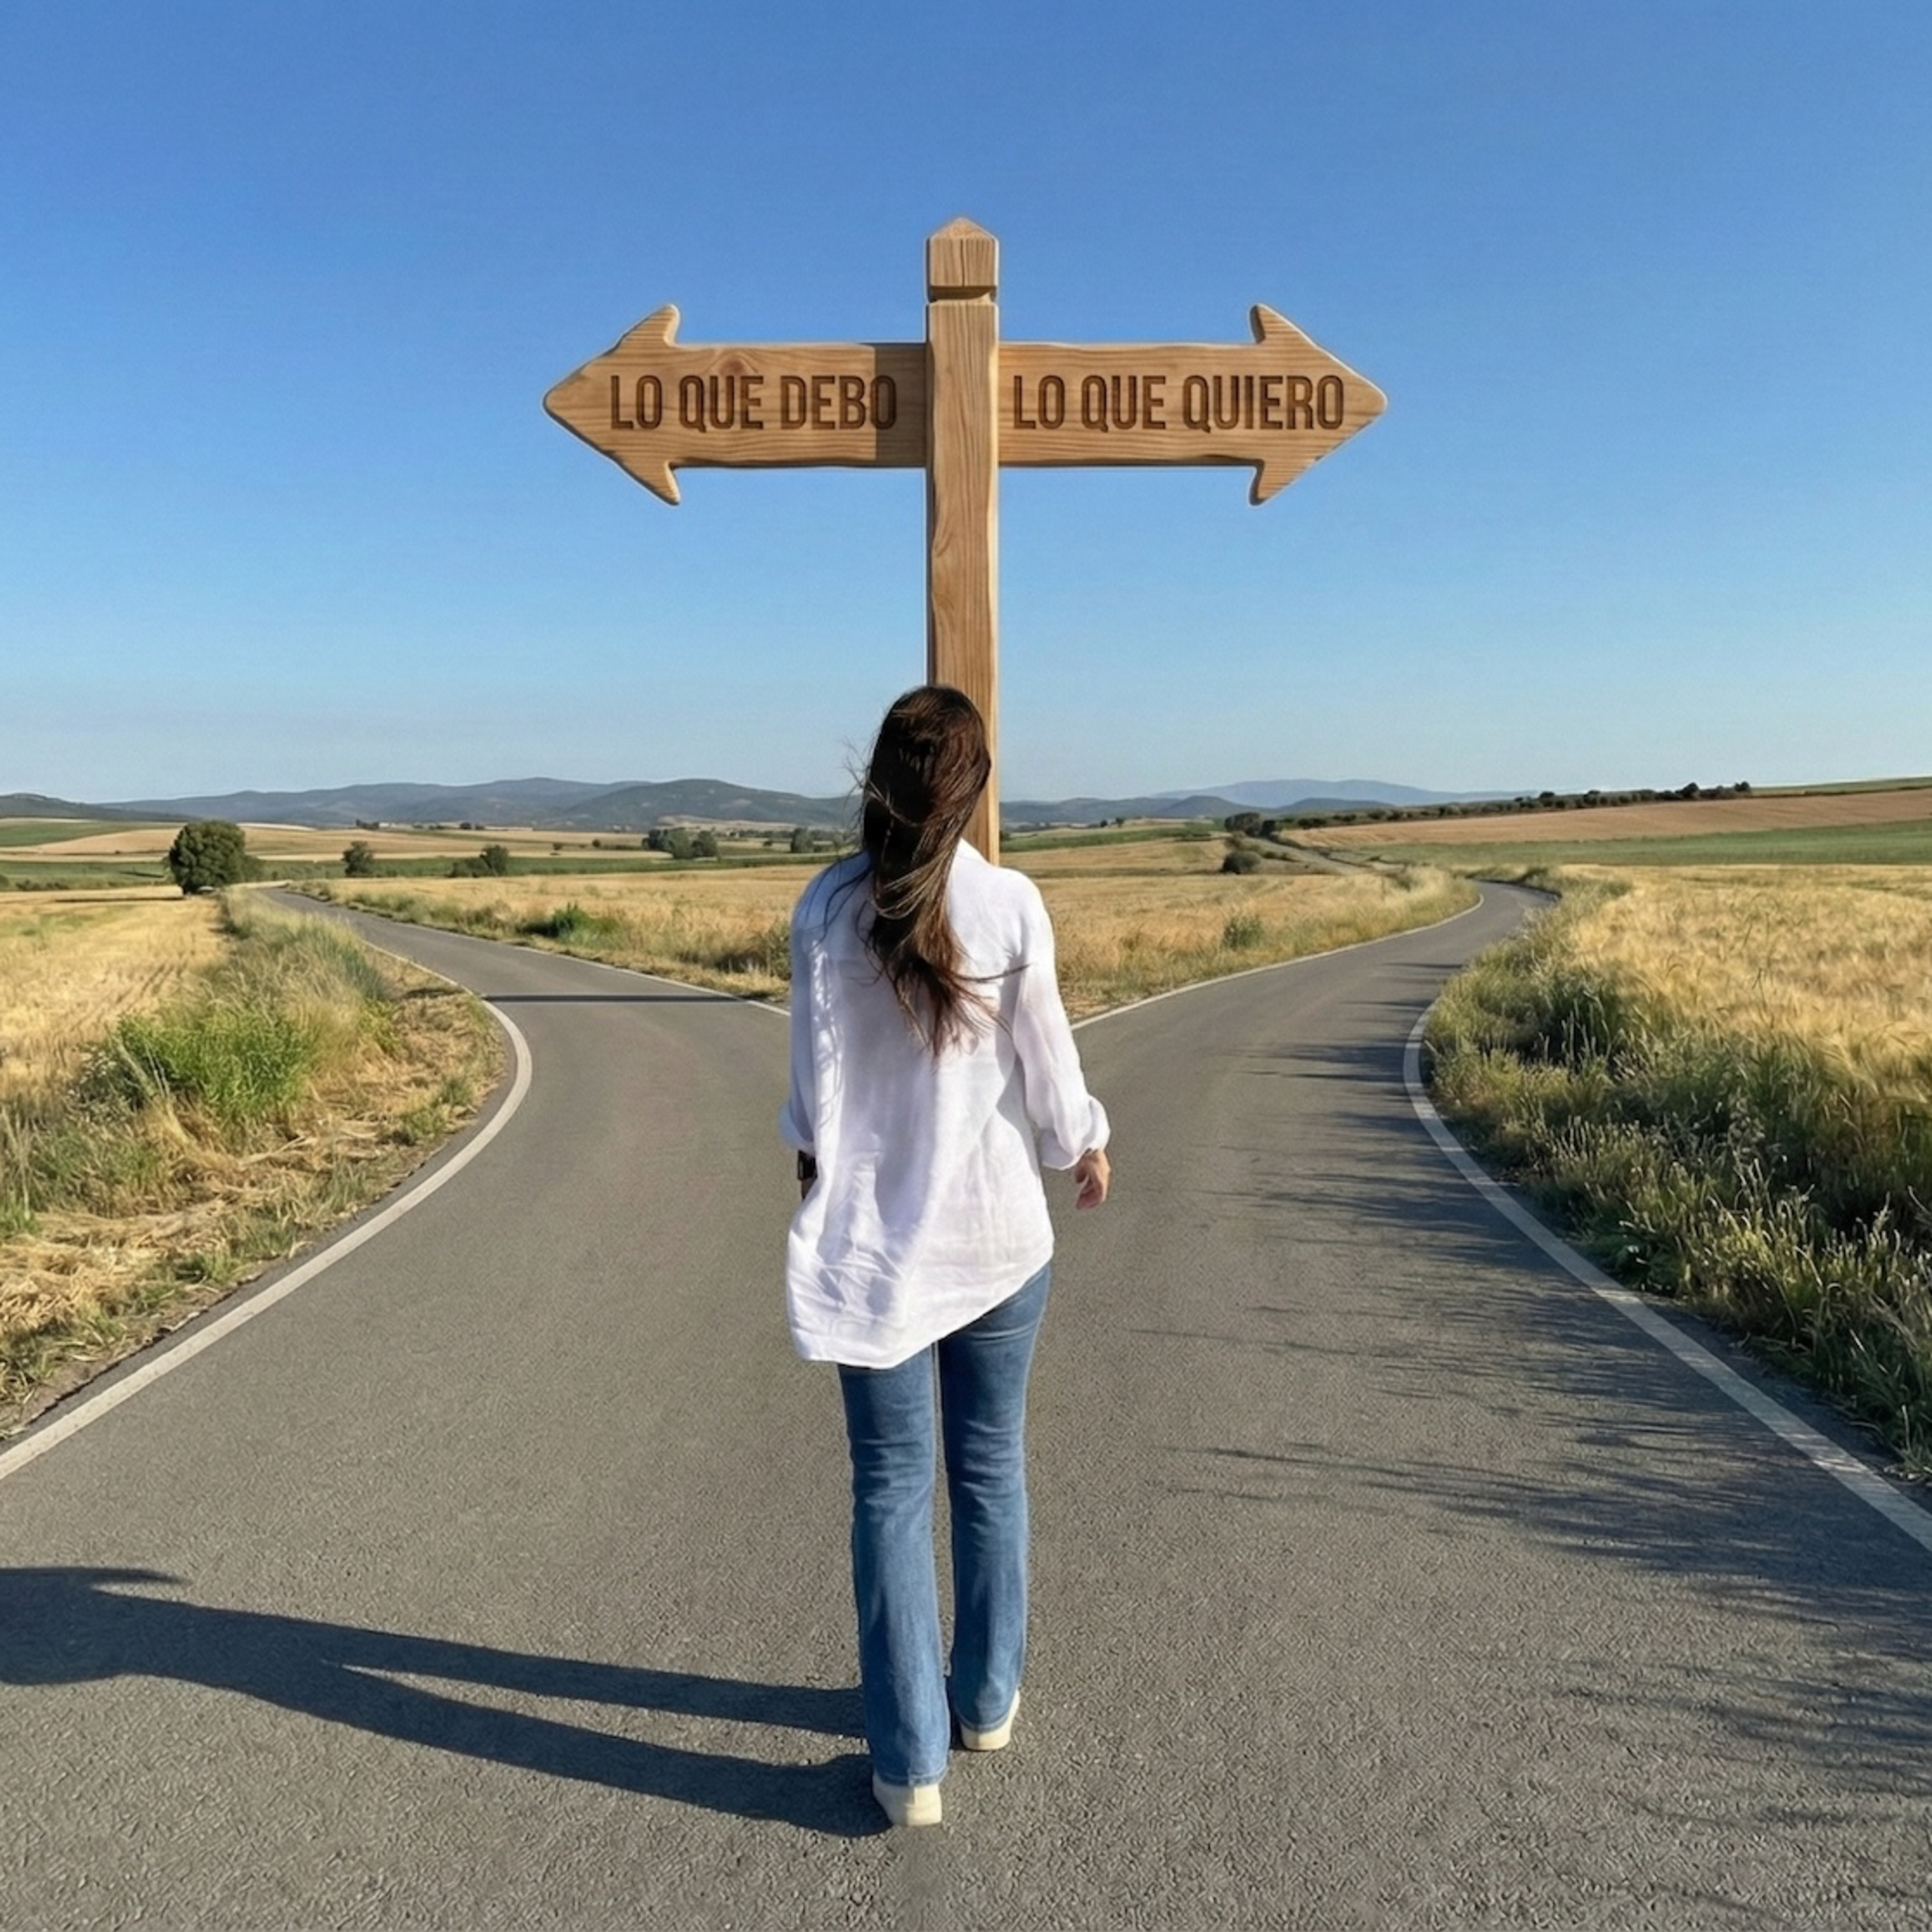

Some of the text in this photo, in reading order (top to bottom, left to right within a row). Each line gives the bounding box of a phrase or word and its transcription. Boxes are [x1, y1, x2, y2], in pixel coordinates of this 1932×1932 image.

[610, 375, 898, 433] LO QUE DEBO
[1013, 375, 1345, 433] LO QUE QUIERO
